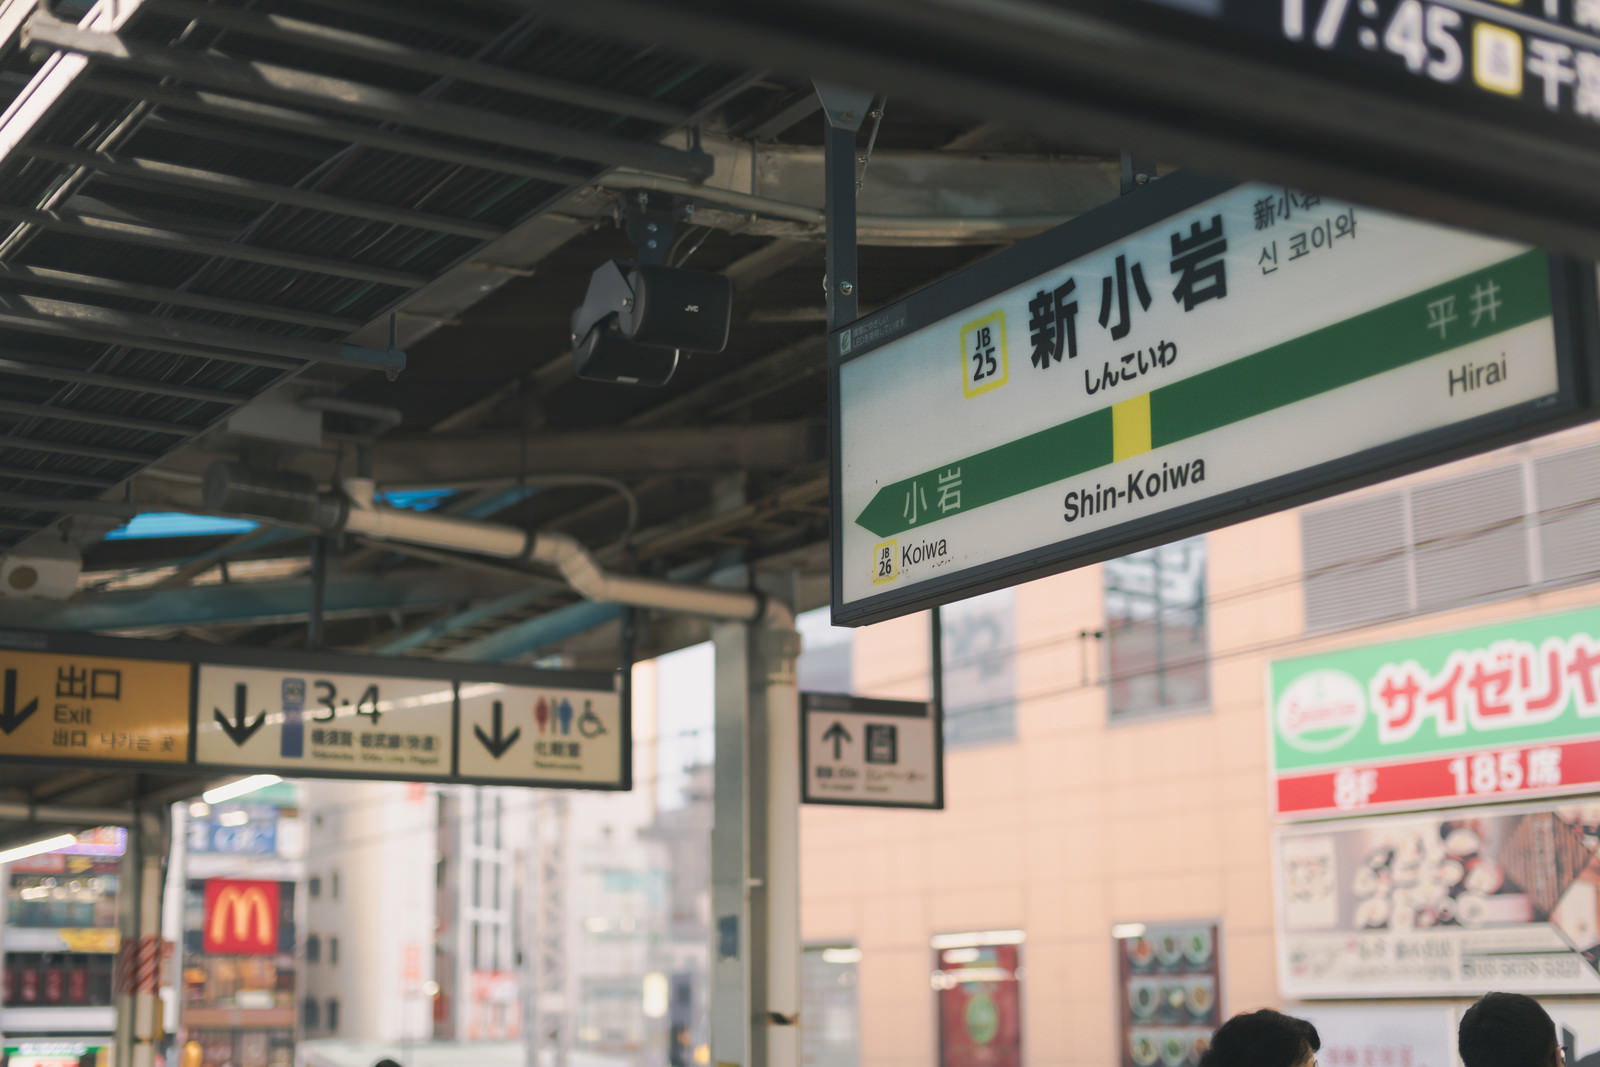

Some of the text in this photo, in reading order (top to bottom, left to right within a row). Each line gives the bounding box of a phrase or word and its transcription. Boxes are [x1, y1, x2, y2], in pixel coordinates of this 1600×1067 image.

[1258, 207, 1358, 275] 신 코이와
[684, 304, 699, 313] JVC
[1028, 213, 1228, 370] 新小岩
[1426, 279, 1503, 340] 平井
[975, 327, 992, 350] JB
[972, 347, 998, 382] 25
[1085, 340, 1178, 395] しんこいわ
[1448, 352, 1508, 397] Hirai
[902, 466, 963, 525] 小岩
[1063, 458, 1206, 523] Shin-Koiwa
[878, 559, 892, 577] 26
[880, 547, 890, 560] JB
[901, 538, 948, 568] Koiwa
[56, 664, 121, 700] 出口
[1373, 638, 1600, 738] サイゼリヤ
[54, 703, 92, 725] Exit
[53, 729, 87, 748] 出口
